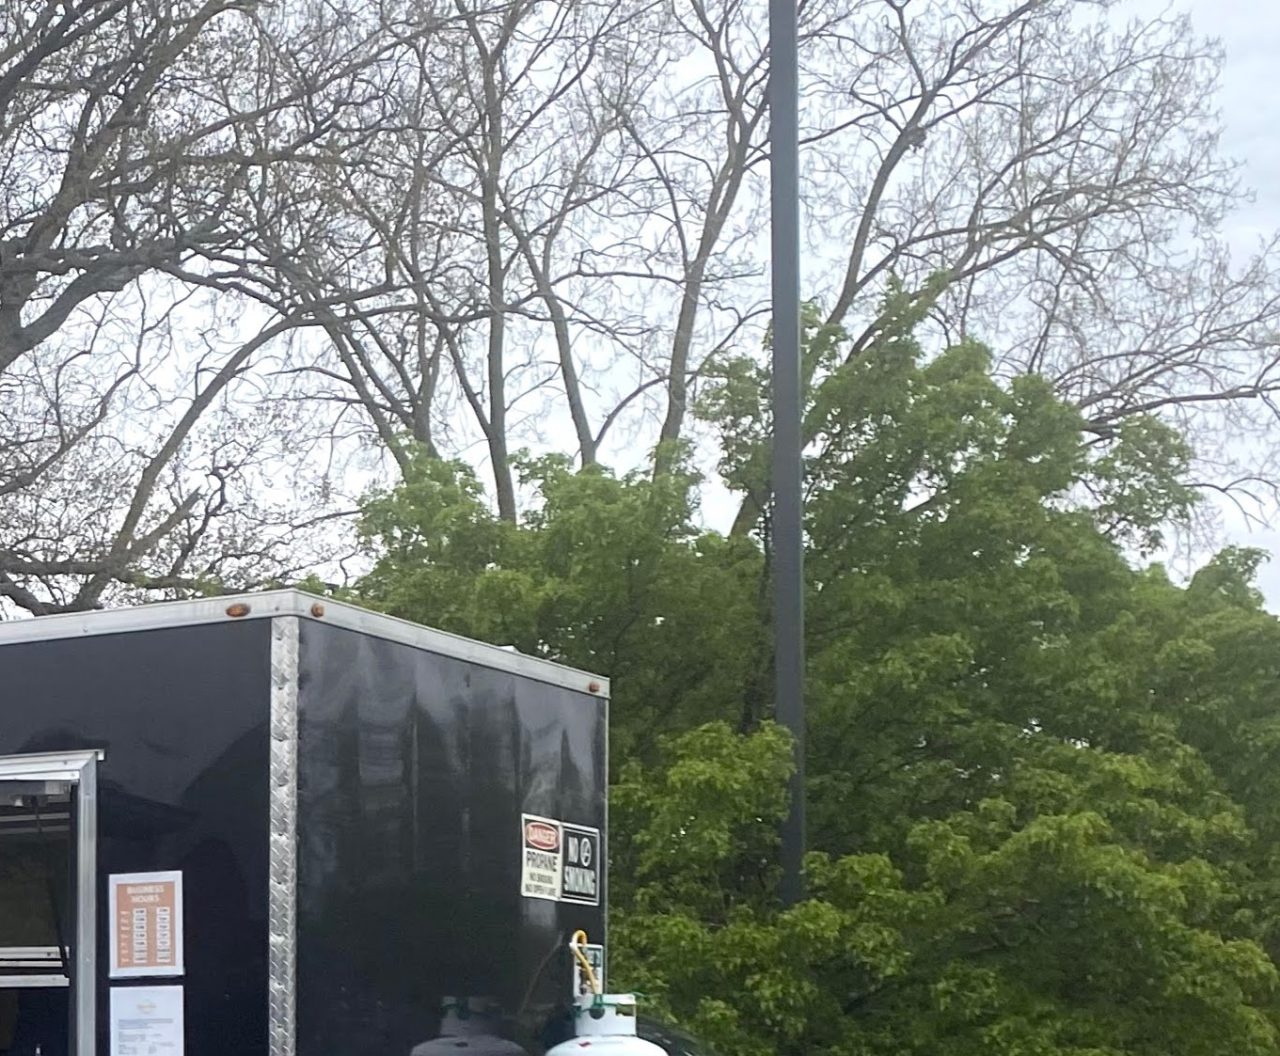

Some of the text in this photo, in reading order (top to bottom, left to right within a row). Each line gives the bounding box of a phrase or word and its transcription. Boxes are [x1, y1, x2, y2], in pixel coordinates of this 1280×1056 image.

[526, 850, 558, 873] PROPANE
[568, 836, 579, 863] NO
[564, 866, 596, 895] SMOKING
